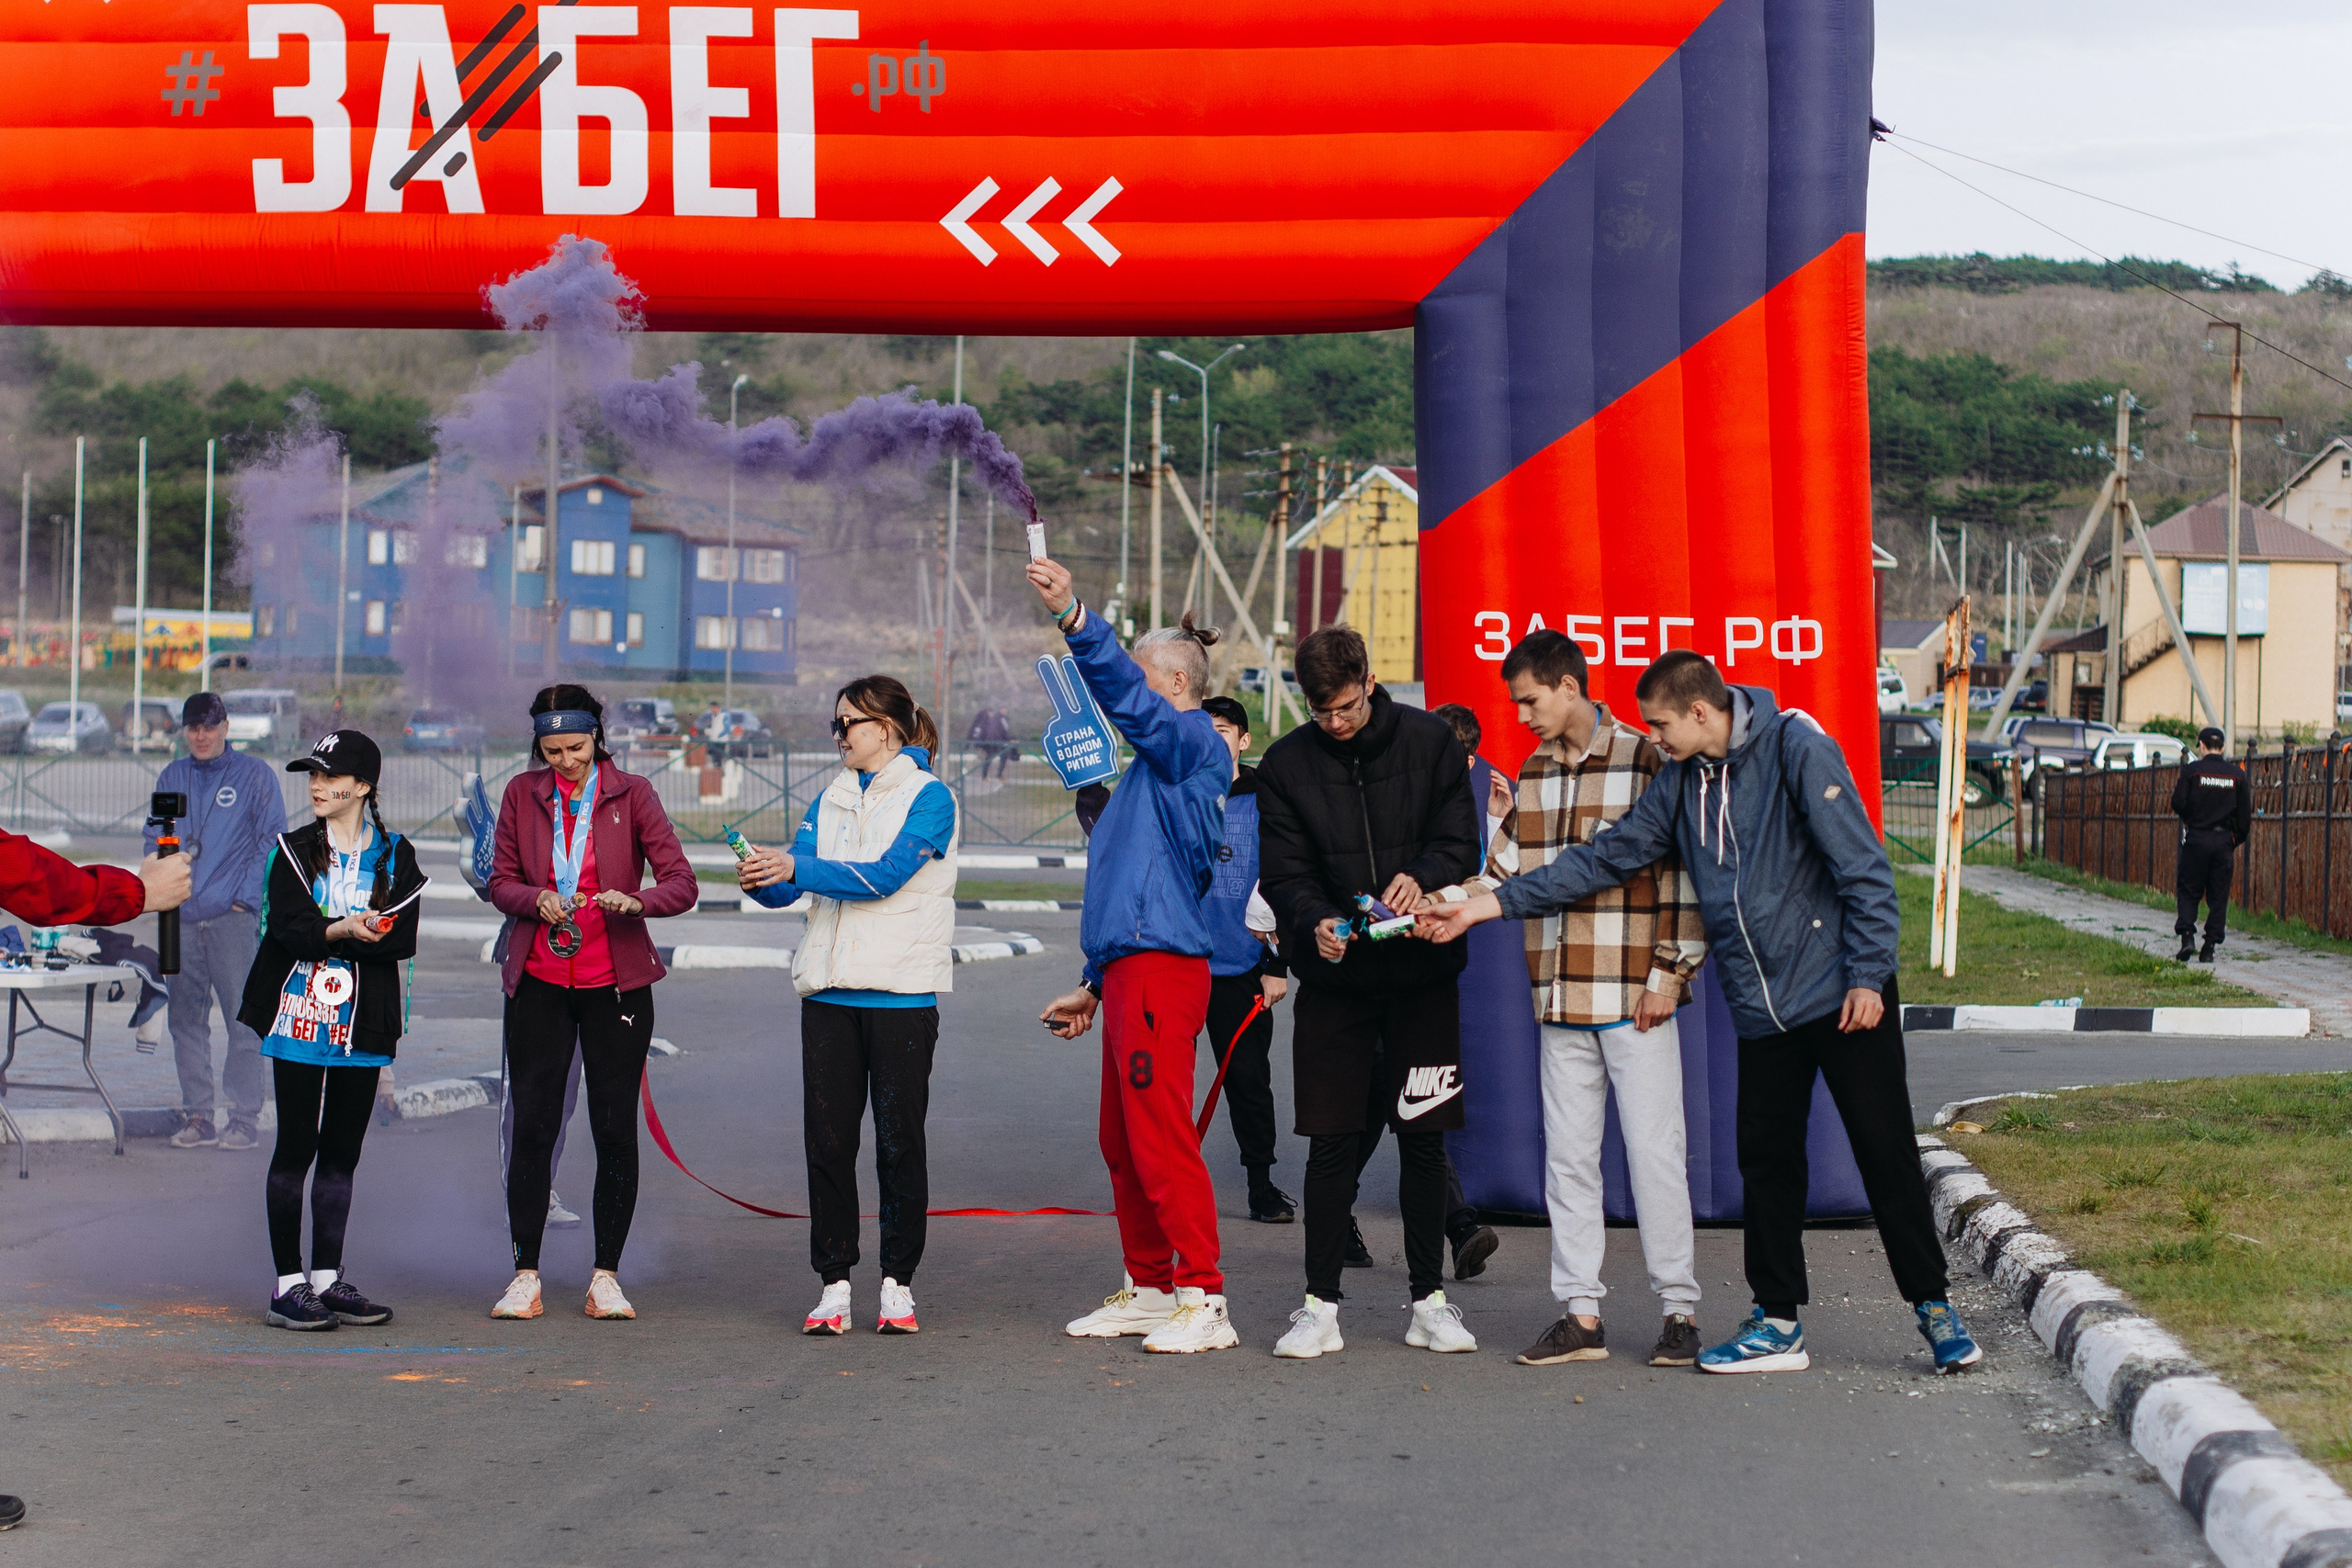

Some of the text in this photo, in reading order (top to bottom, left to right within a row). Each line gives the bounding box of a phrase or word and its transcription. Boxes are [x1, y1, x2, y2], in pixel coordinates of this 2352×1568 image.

[1054, 726, 1096, 747] СТРАНА
[1057, 738, 1102, 761] В ОДНОМ
[1066, 752, 1102, 773] РИТМЕ
[2200, 775, 2233, 789] ПОЛИЦИЯ
[1129, 1050, 1153, 1090] 8
[1405, 1066, 1457, 1097] NIKE
